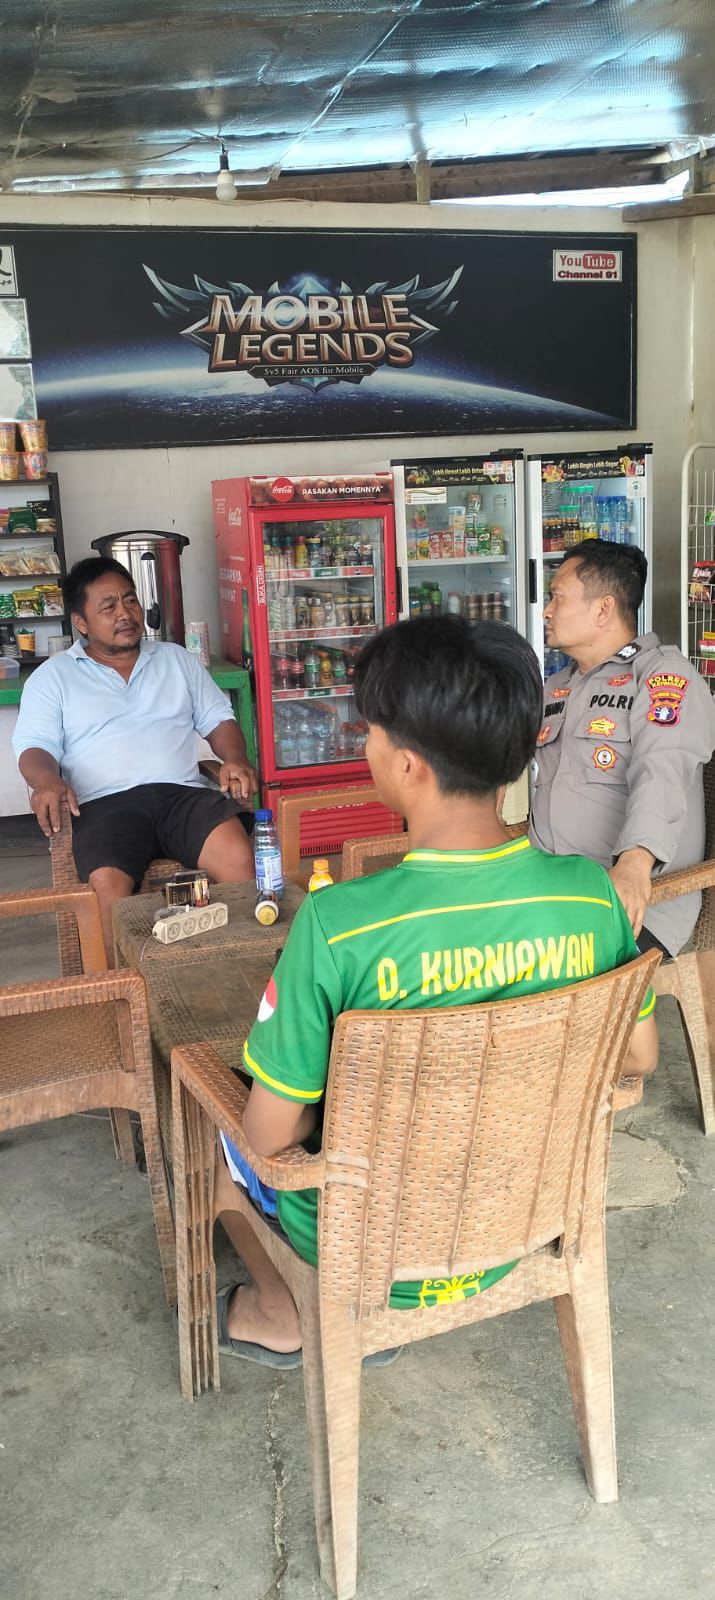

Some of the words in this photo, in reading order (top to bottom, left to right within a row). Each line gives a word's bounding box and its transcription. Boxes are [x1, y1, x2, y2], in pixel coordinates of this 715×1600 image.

[559, 254, 615, 268] YouTube
[557, 270, 603, 279] Channel
[605, 271, 618, 279] 91
[201, 294, 423, 333] MOBILE
[211, 331, 413, 369] LEGENDS
[264, 366, 280, 375] 5v5
[281, 366, 298, 375] Fair
[300, 366, 320, 375] AOS
[322, 365, 334, 375] for
[335, 365, 364, 375] Mobile
[302, 486, 338, 496] RASAKAN
[590, 694, 634, 711] POLRI
[377, 957, 408, 1001] D.
[421, 932, 595, 995] KURNIAWAN
